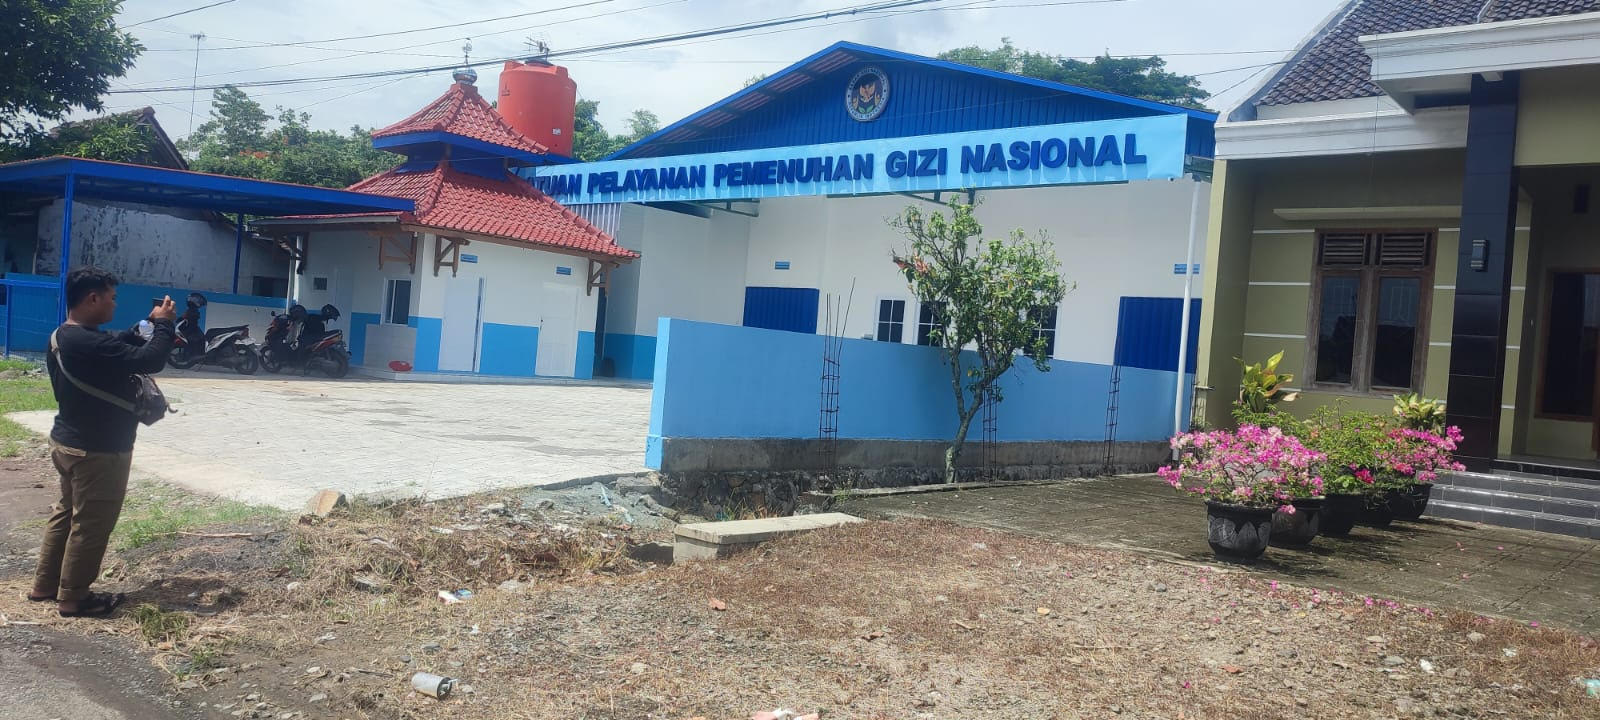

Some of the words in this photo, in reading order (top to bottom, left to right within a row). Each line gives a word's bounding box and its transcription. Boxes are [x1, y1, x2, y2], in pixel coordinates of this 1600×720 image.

[587, 164, 706, 194] PELAYANAN
[713, 153, 874, 187] PEMENUHAN
[885, 147, 948, 178] GIZI
[960, 133, 1147, 174] NASIONAL
